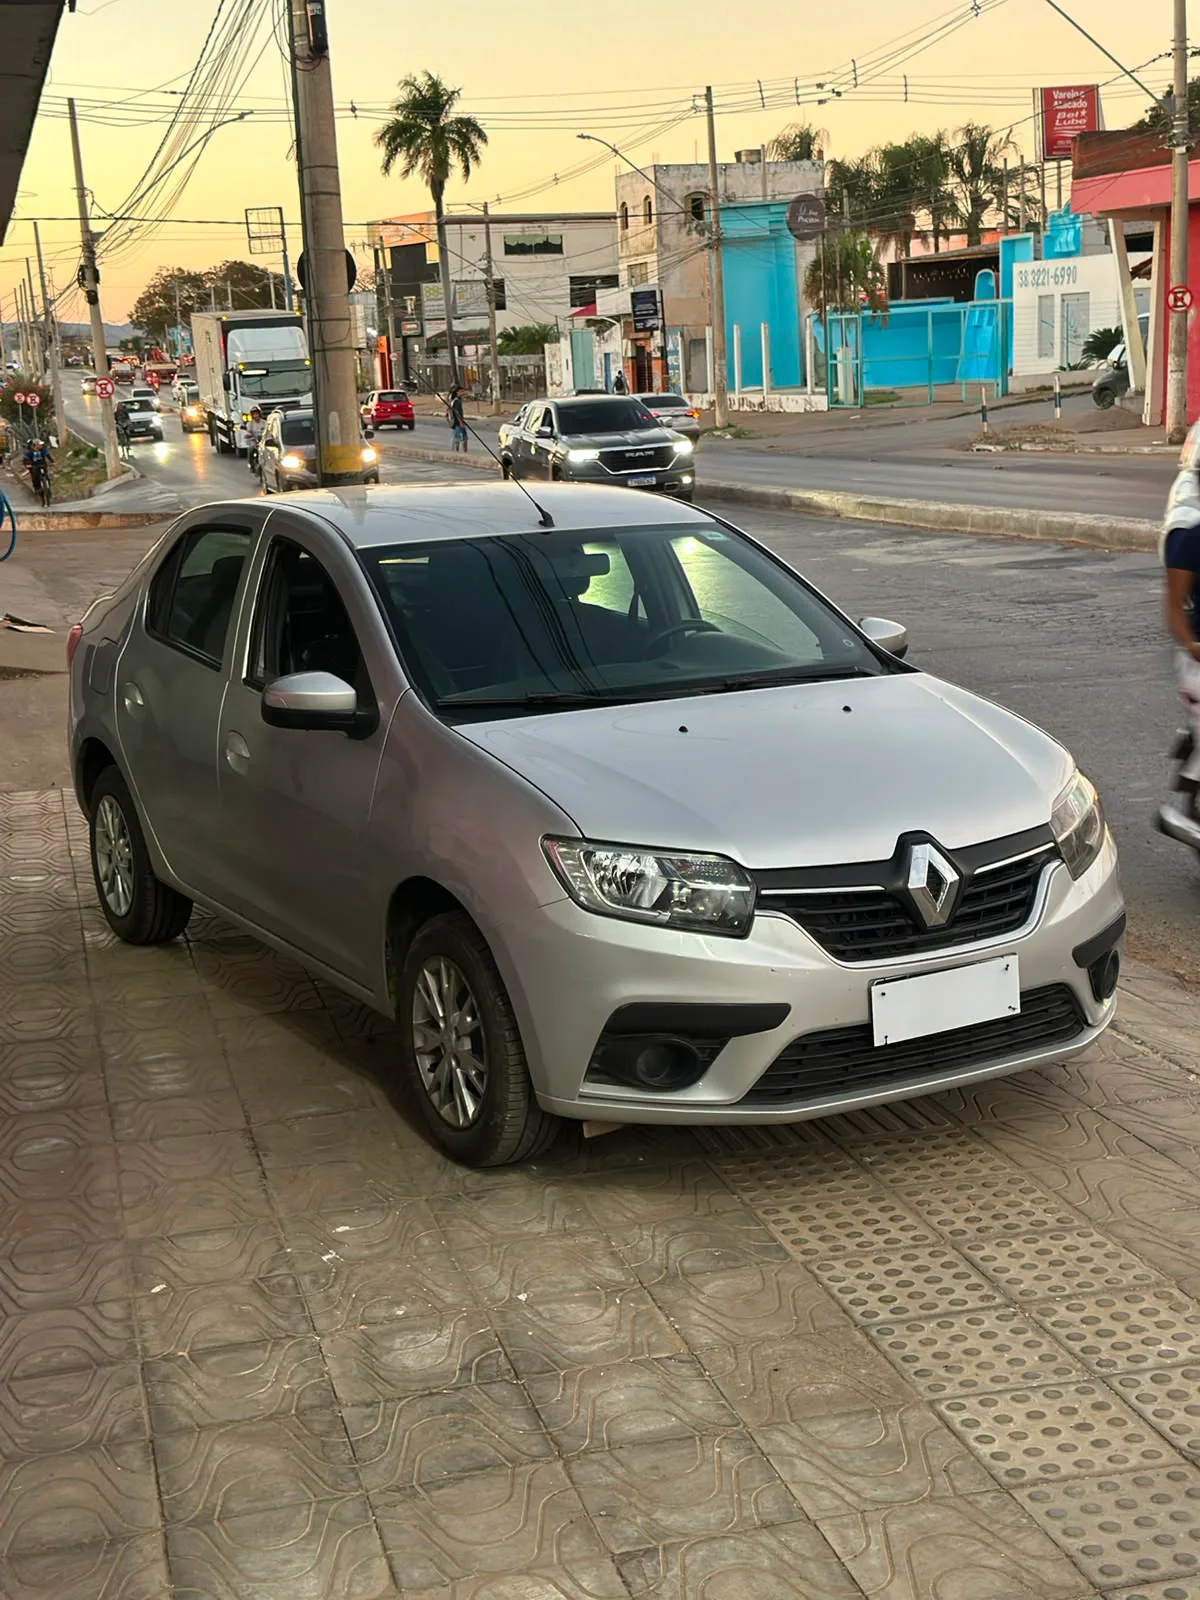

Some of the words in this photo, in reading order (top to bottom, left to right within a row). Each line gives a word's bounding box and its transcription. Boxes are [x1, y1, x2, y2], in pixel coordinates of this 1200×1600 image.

[1056, 111, 1079, 119] Bel
[1055, 118, 1087, 126] Lube
[1018, 269, 1029, 288] 38
[1030, 265, 1078, 287] 3221-6990
